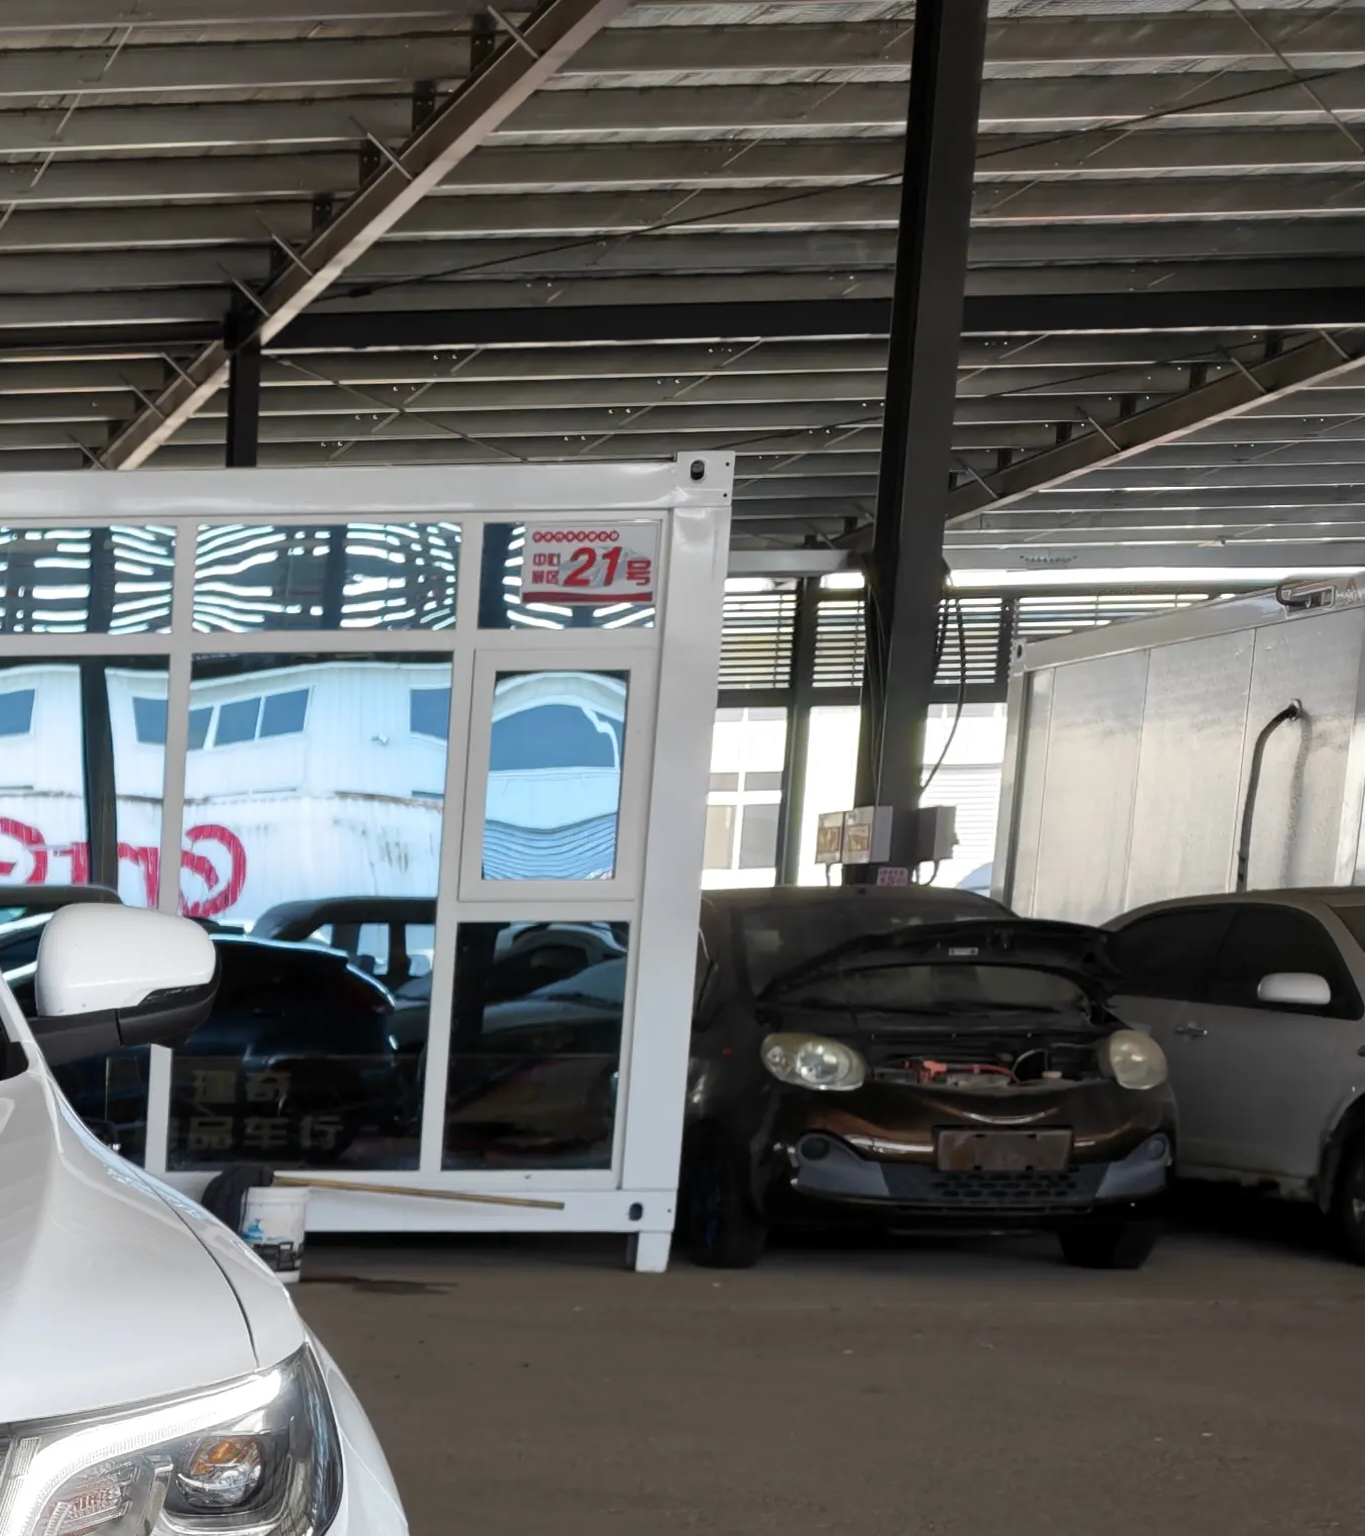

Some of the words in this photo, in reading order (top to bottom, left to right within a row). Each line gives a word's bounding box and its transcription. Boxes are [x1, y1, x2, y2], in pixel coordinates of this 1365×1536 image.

[564, 546, 652, 587] 21号
[170, 1115, 344, 1151] 品车行
